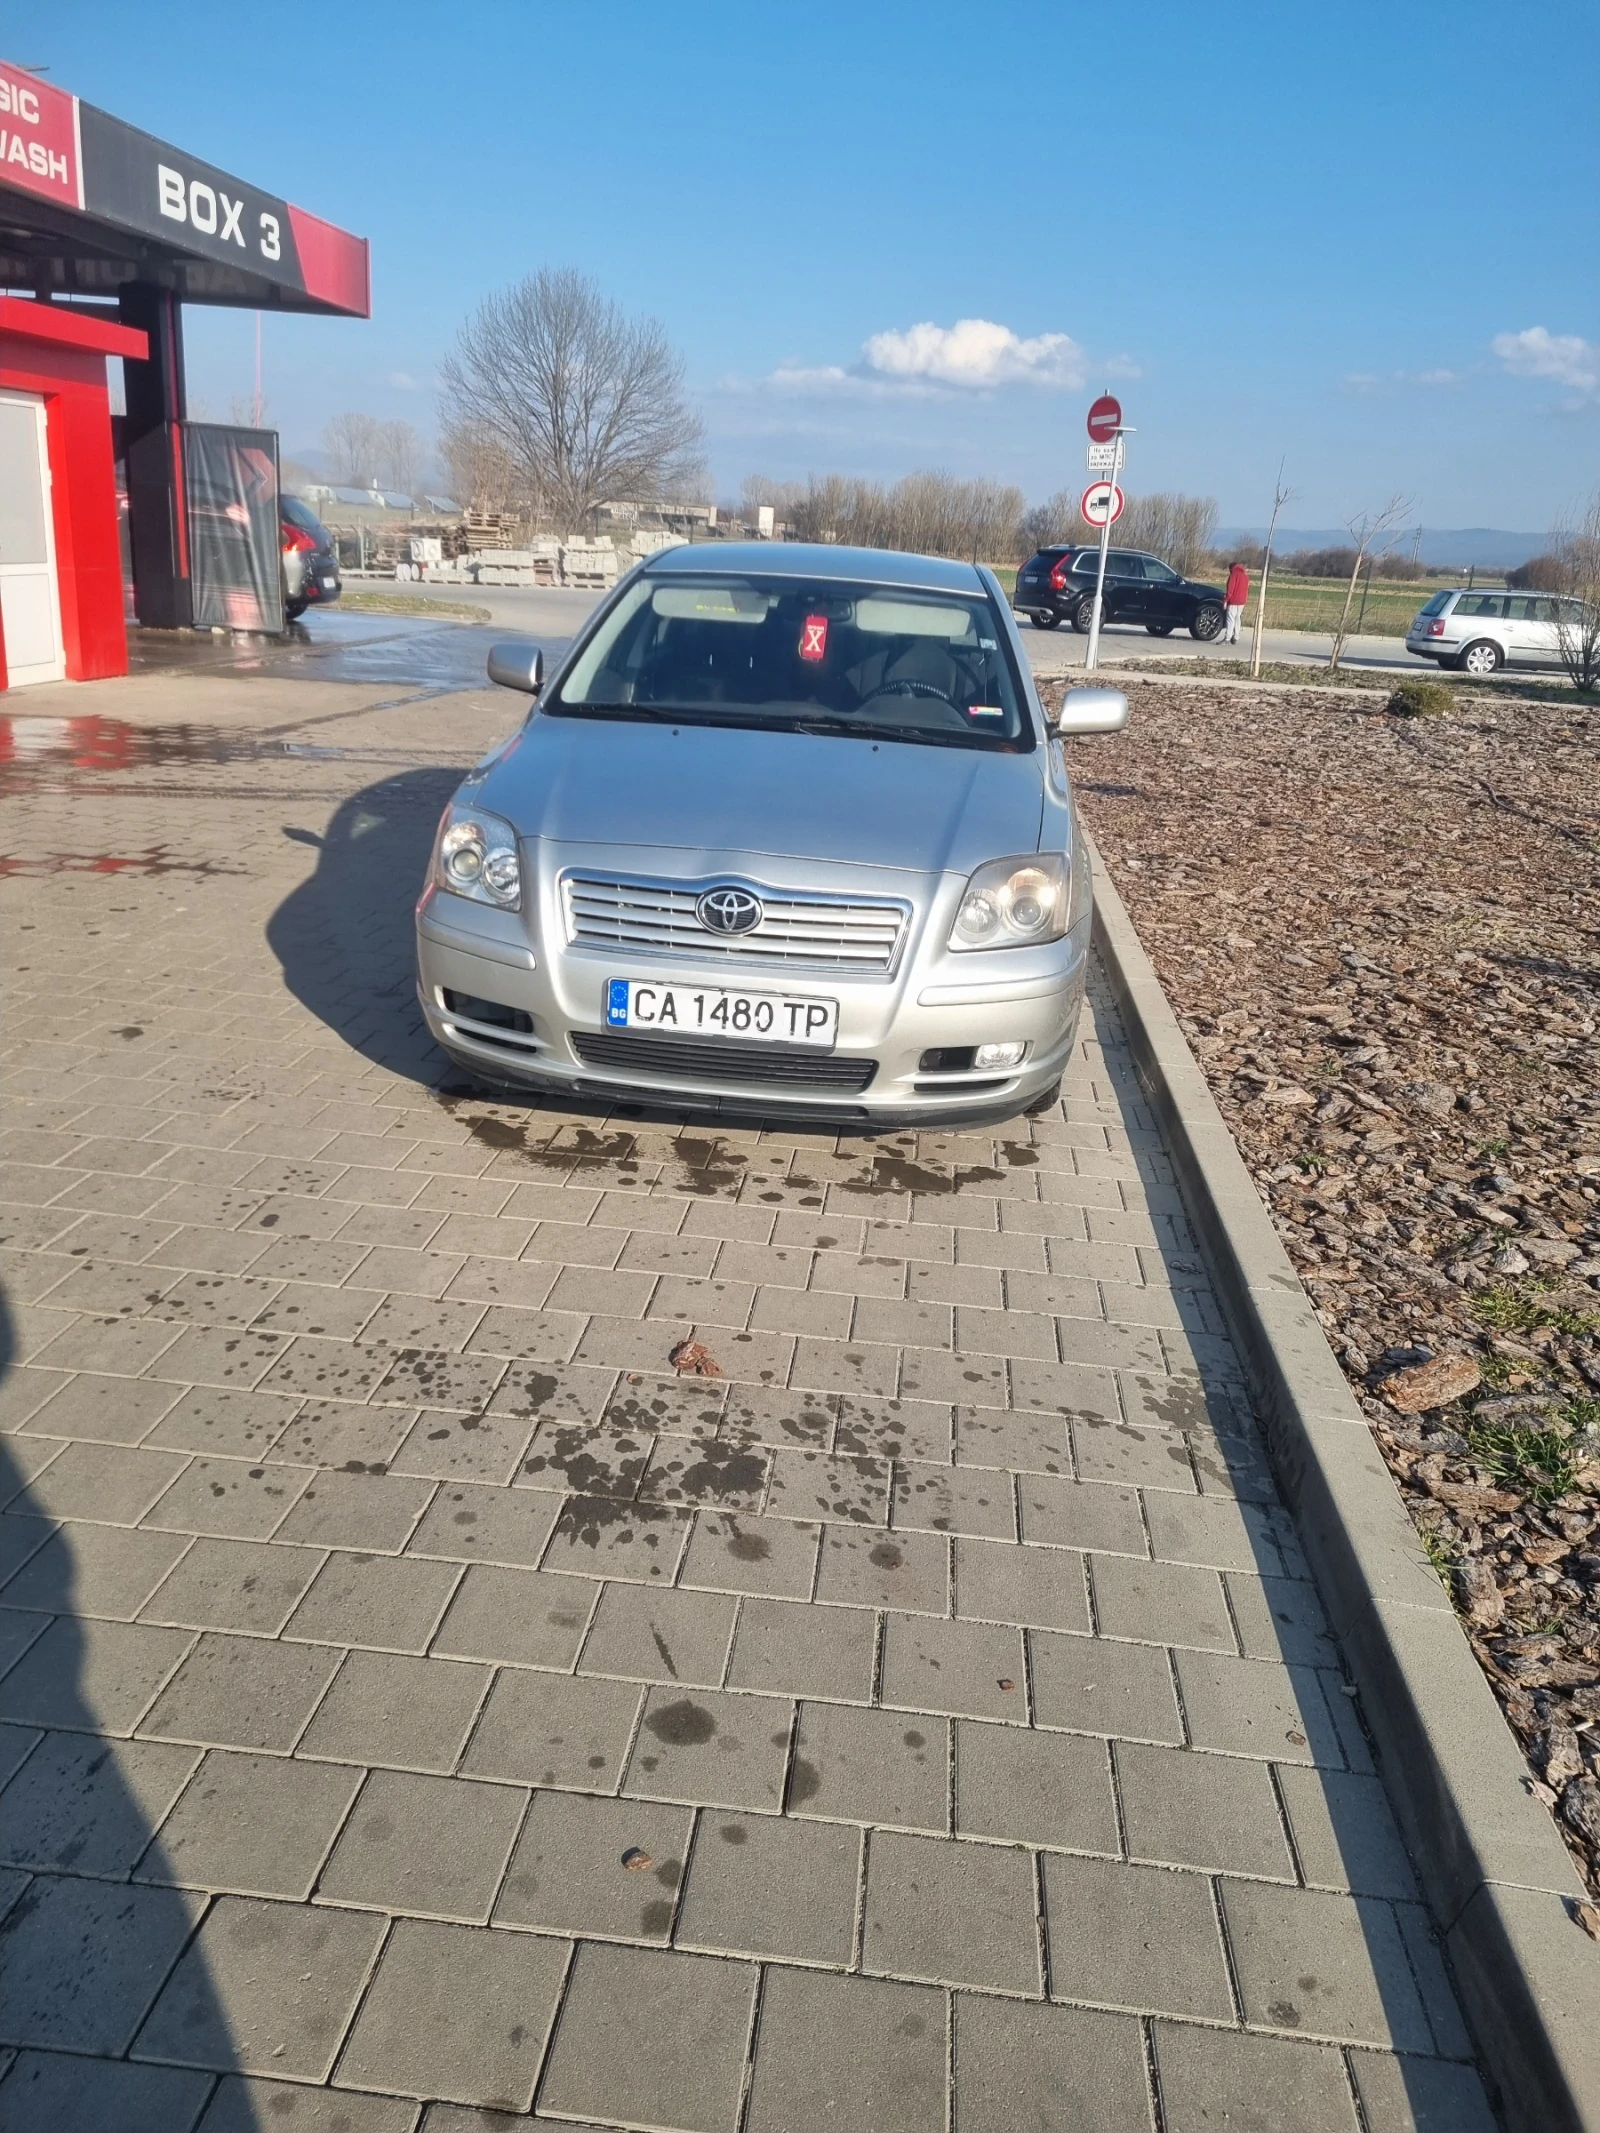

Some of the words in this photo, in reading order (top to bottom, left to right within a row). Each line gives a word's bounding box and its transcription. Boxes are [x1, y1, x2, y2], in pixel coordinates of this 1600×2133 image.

[158, 163, 246, 248] BOX
[260, 213, 281, 261] 3
[611, 1007, 627, 1019] BG
[634, 988, 678, 1025] CA
[693, 994, 774, 1032] 1480
[783, 1002, 829, 1038] TP
